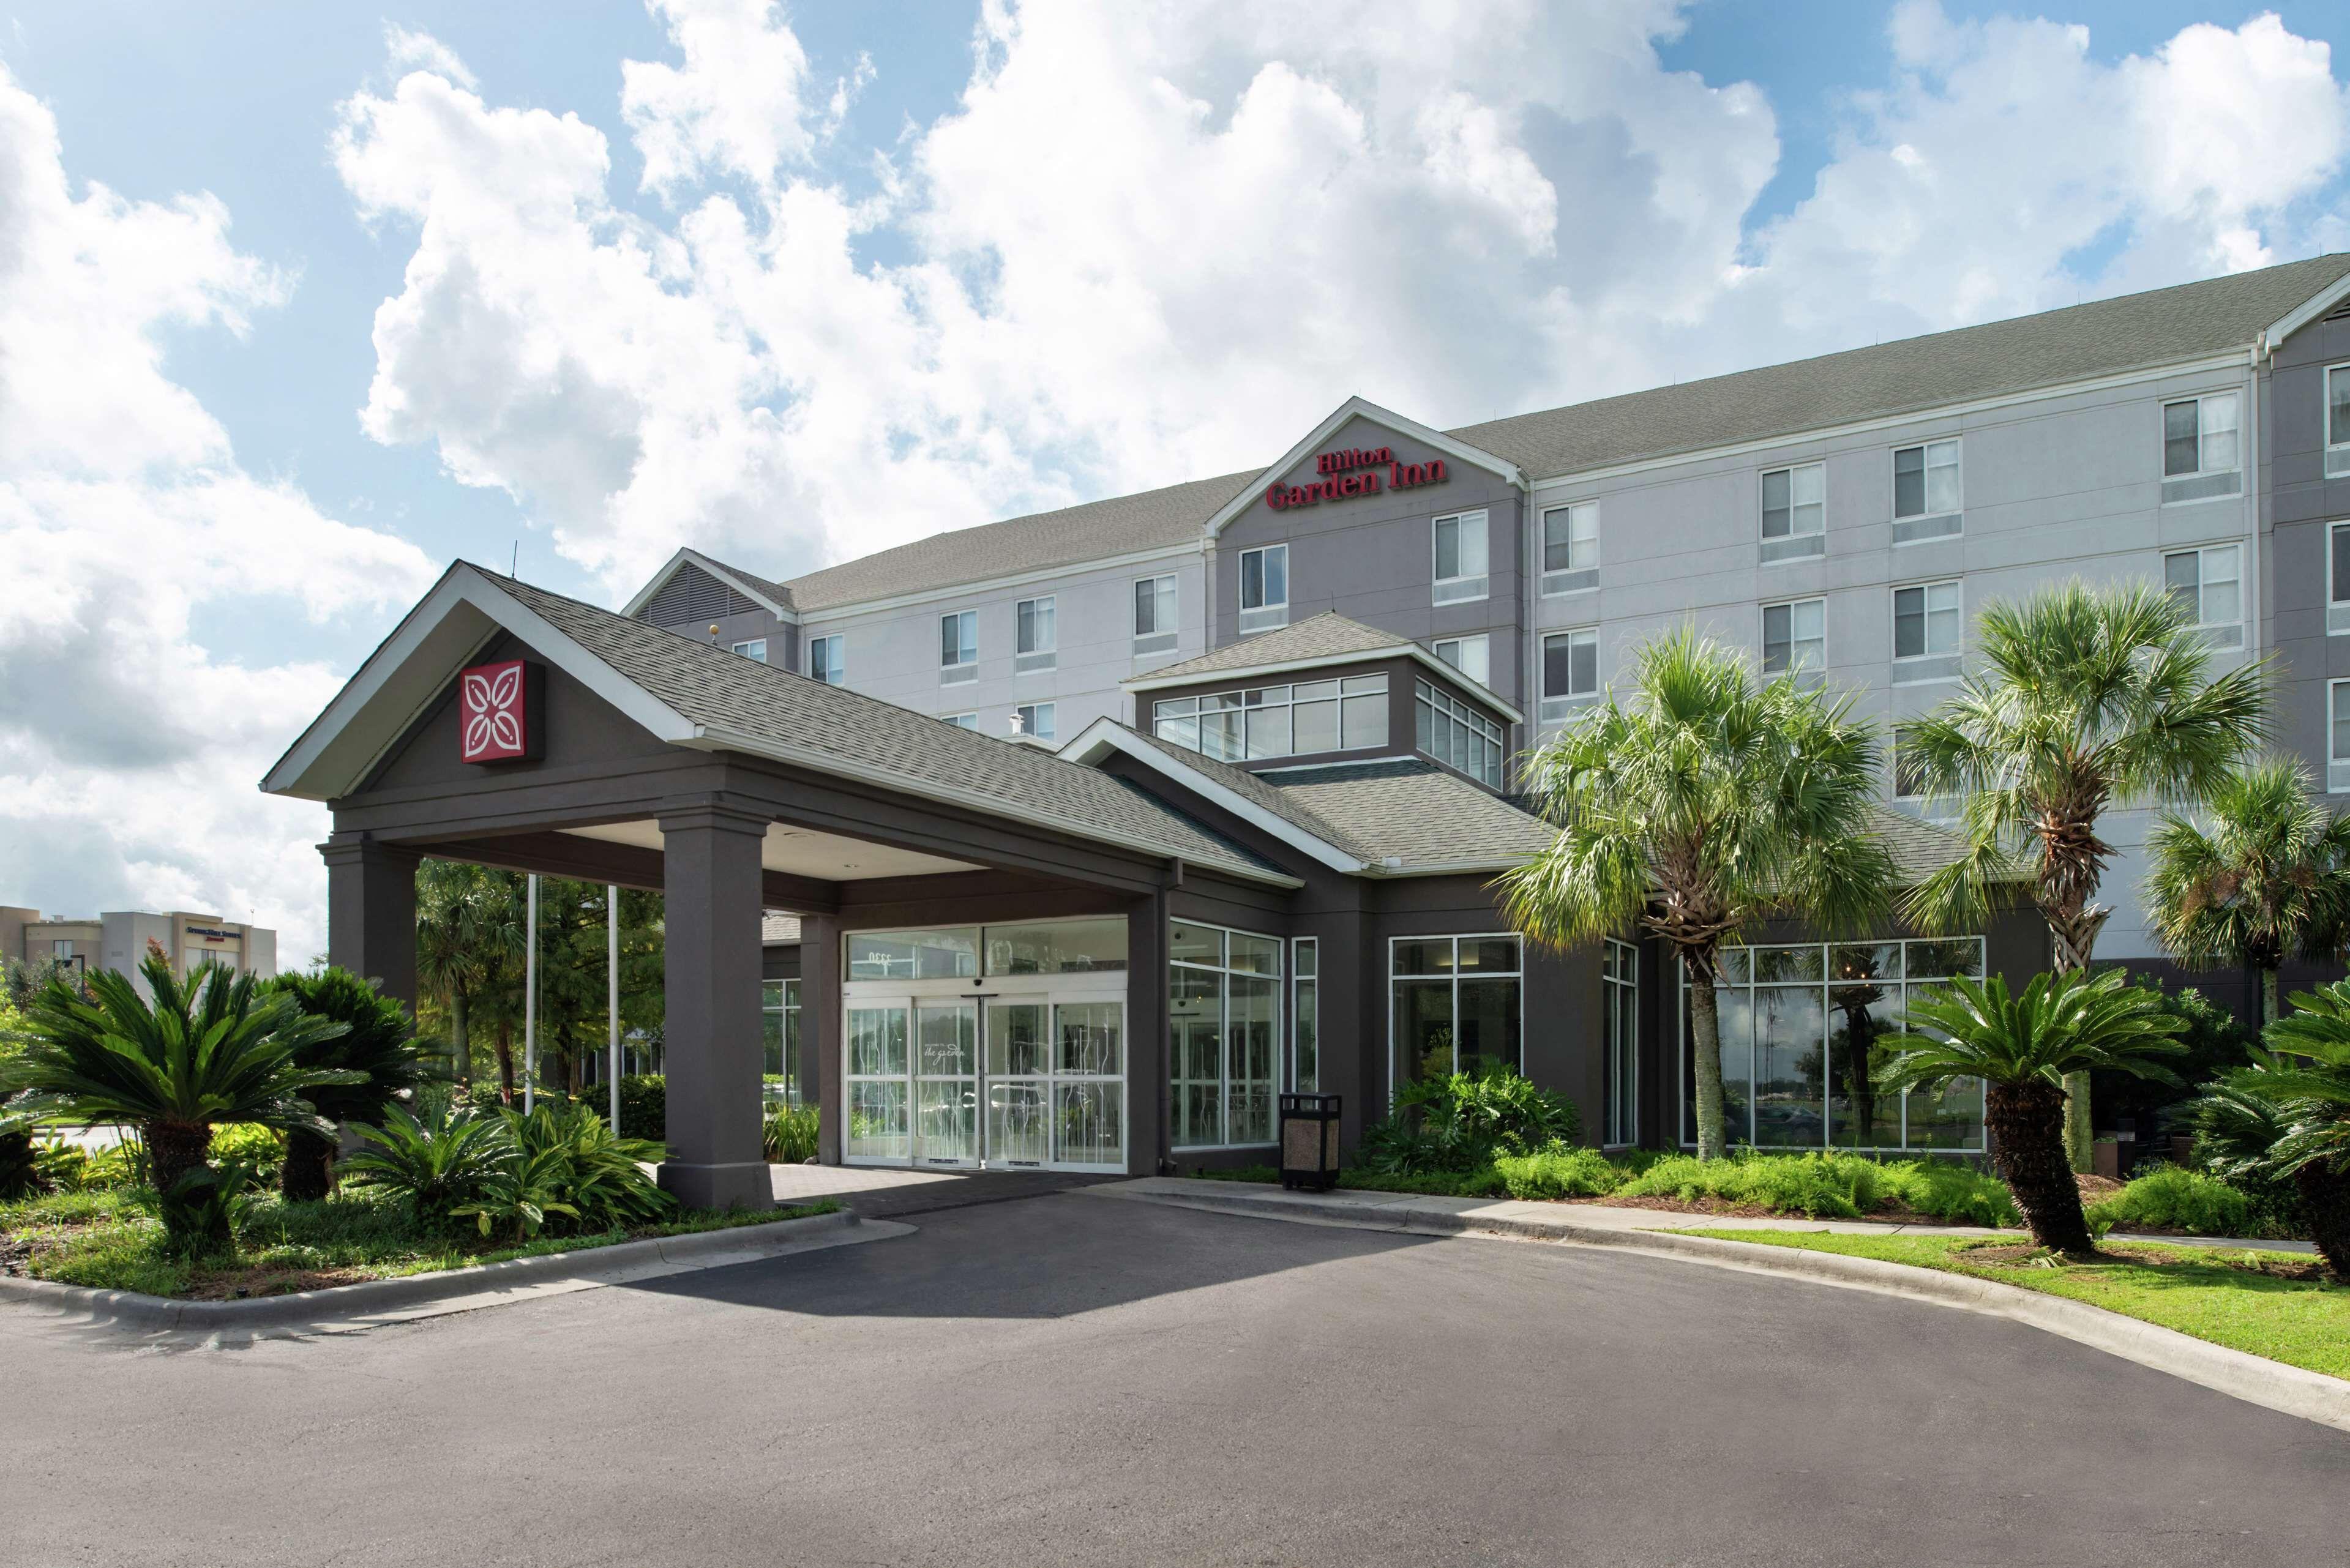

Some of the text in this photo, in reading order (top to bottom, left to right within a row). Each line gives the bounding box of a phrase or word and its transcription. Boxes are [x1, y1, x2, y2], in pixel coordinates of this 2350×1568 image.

[1316, 447, 1391, 474] Hilton
[1266, 460, 1446, 509] Garden Inn
